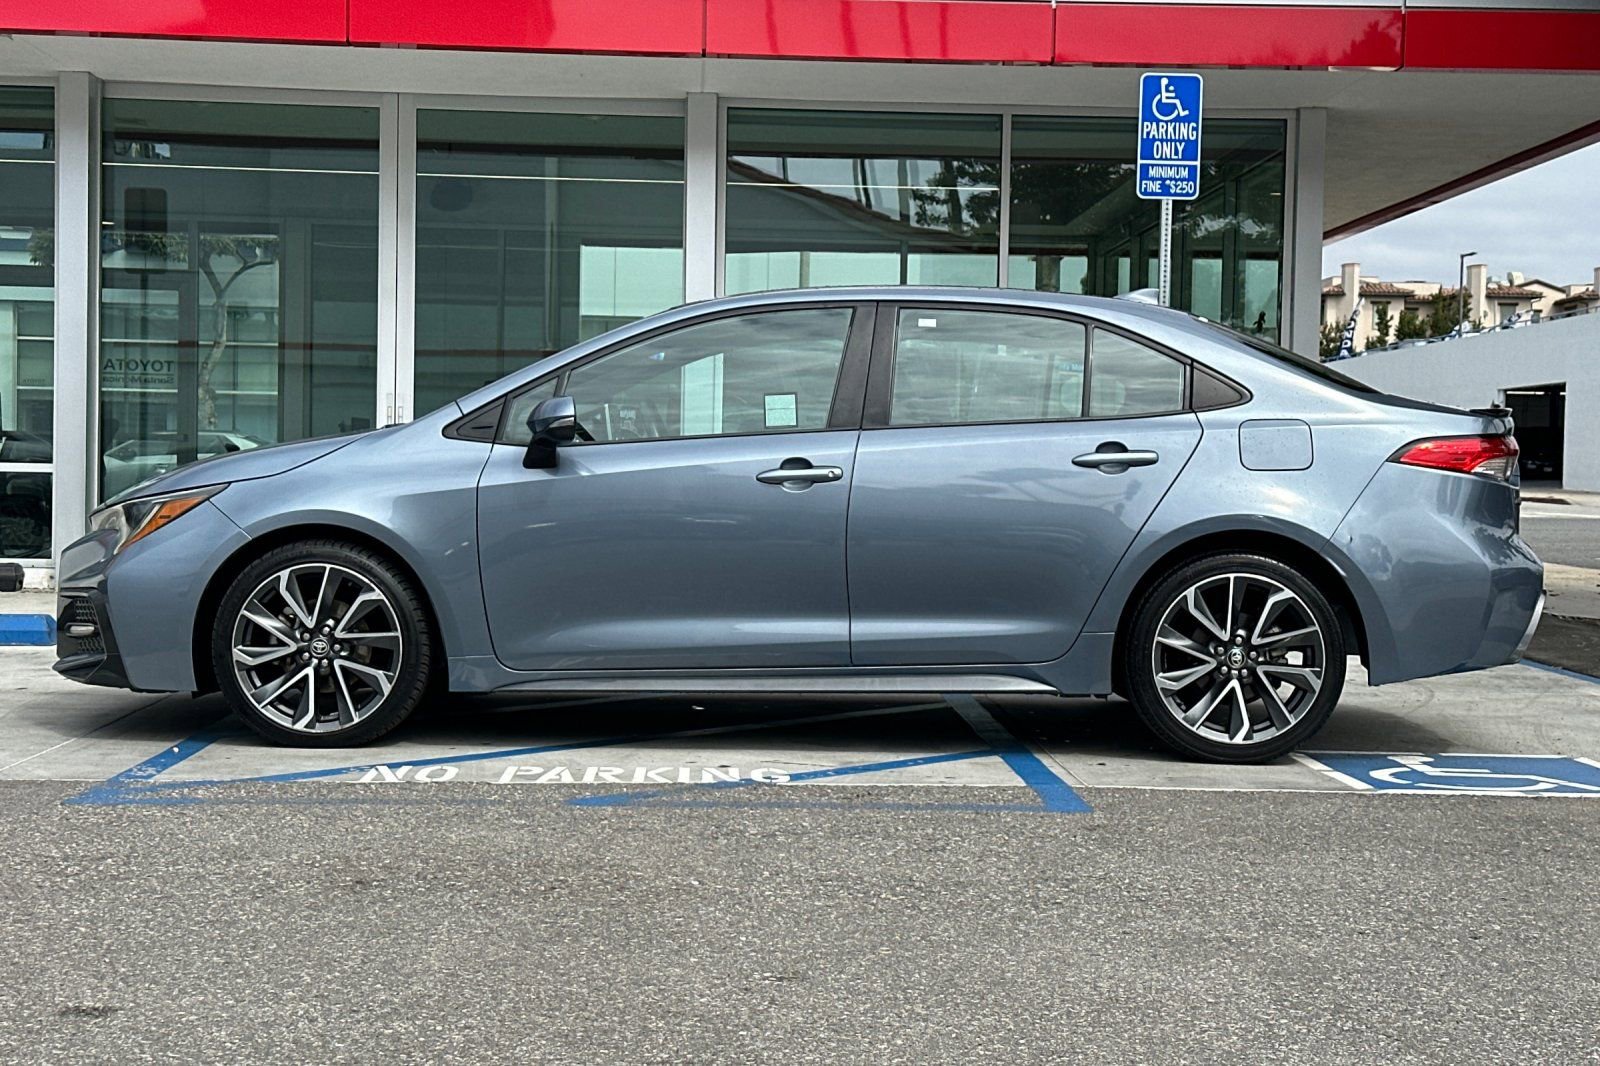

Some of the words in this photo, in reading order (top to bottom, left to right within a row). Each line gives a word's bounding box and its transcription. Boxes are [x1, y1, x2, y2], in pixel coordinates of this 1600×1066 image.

[1143, 122, 1197, 140] PARKING
[1153, 141, 1185, 159] ONLY
[1148, 166, 1188, 178] MINIMUM
[1141, 181, 1162, 192] FINE
[1169, 181, 1194, 193] $250
[1340, 309, 1361, 358] ONDA
[359, 765, 460, 782] NO
[498, 766, 791, 783] PARKING
